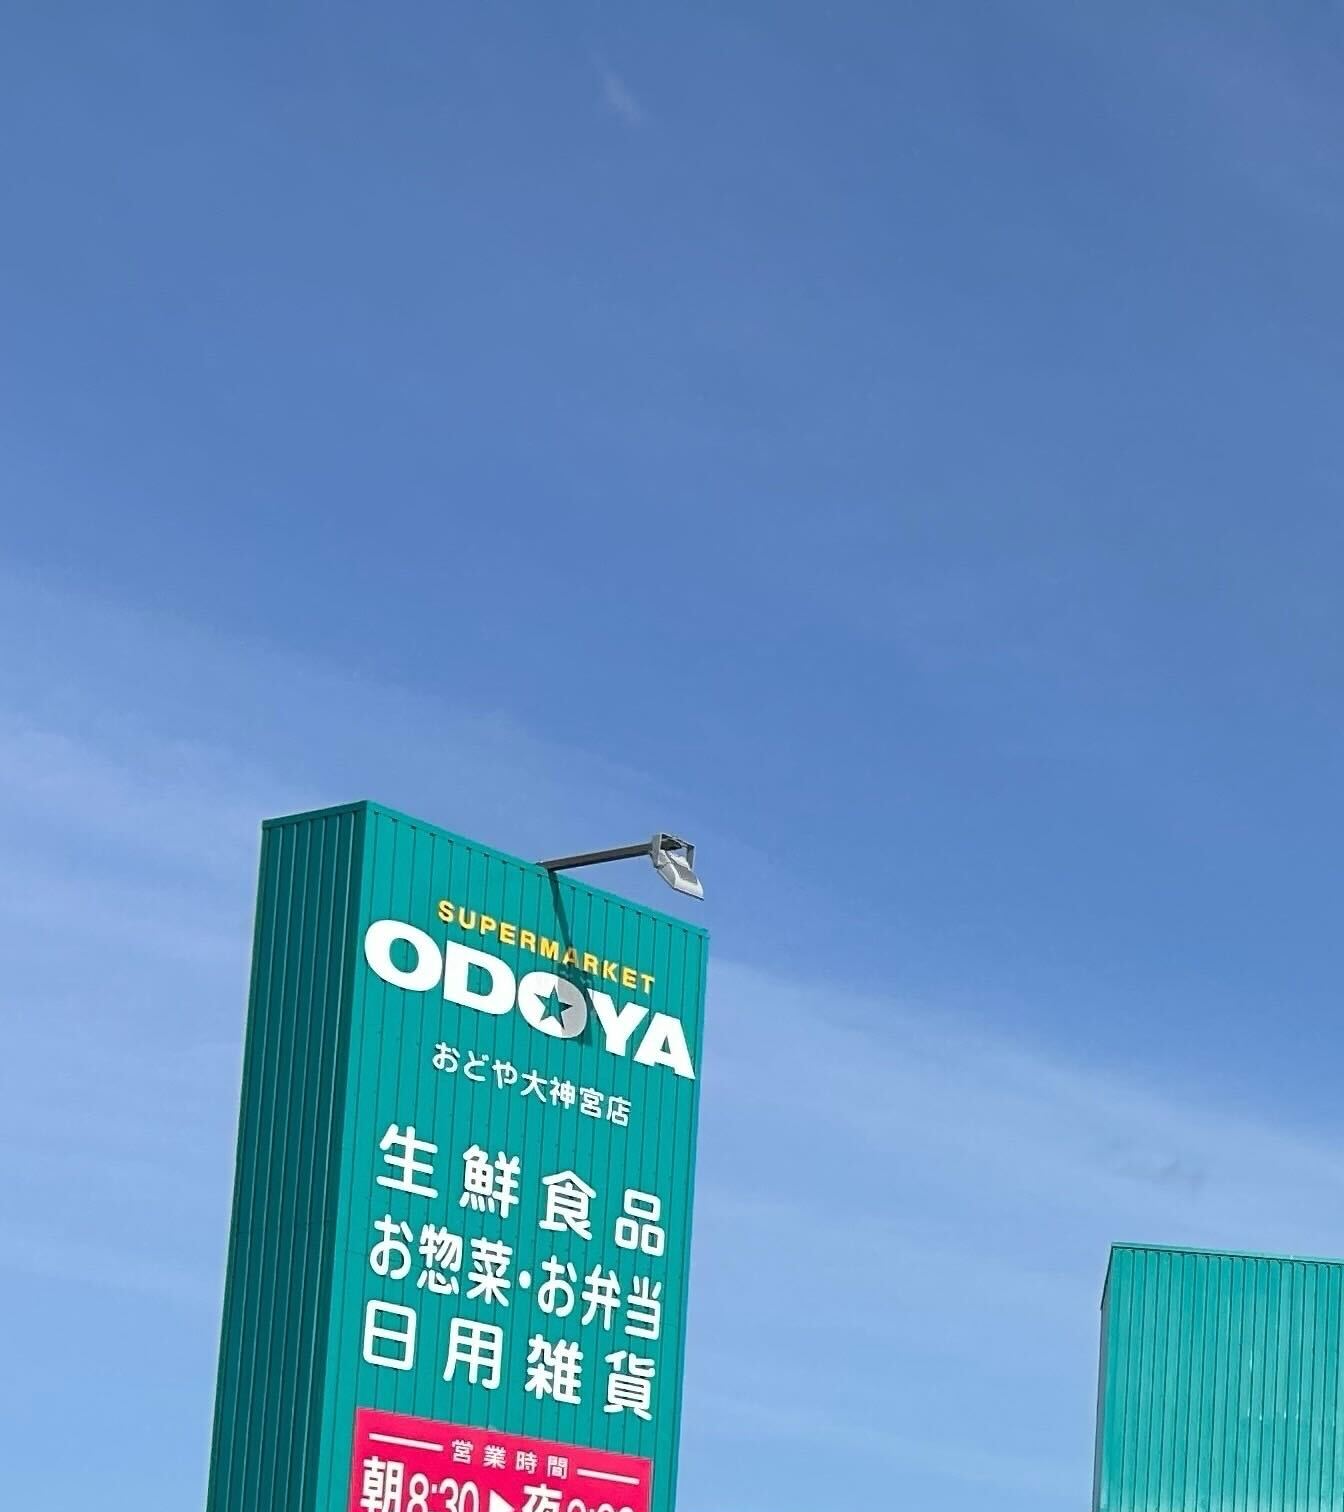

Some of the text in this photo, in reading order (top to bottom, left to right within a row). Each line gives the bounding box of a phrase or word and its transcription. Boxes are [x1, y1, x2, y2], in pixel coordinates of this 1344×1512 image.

[364, 919, 696, 1080] ODOYA
[437, 899, 656, 995] SUPERMARKET
[431, 1041, 632, 1127] おどや大神宮店
[376, 1122, 666, 1257] 生鮮食品
[369, 1213, 662, 1341] お惣菜・お弁当
[362, 1299, 656, 1421] 日用雑貨
[451, 1439, 569, 1480] 営業時間
